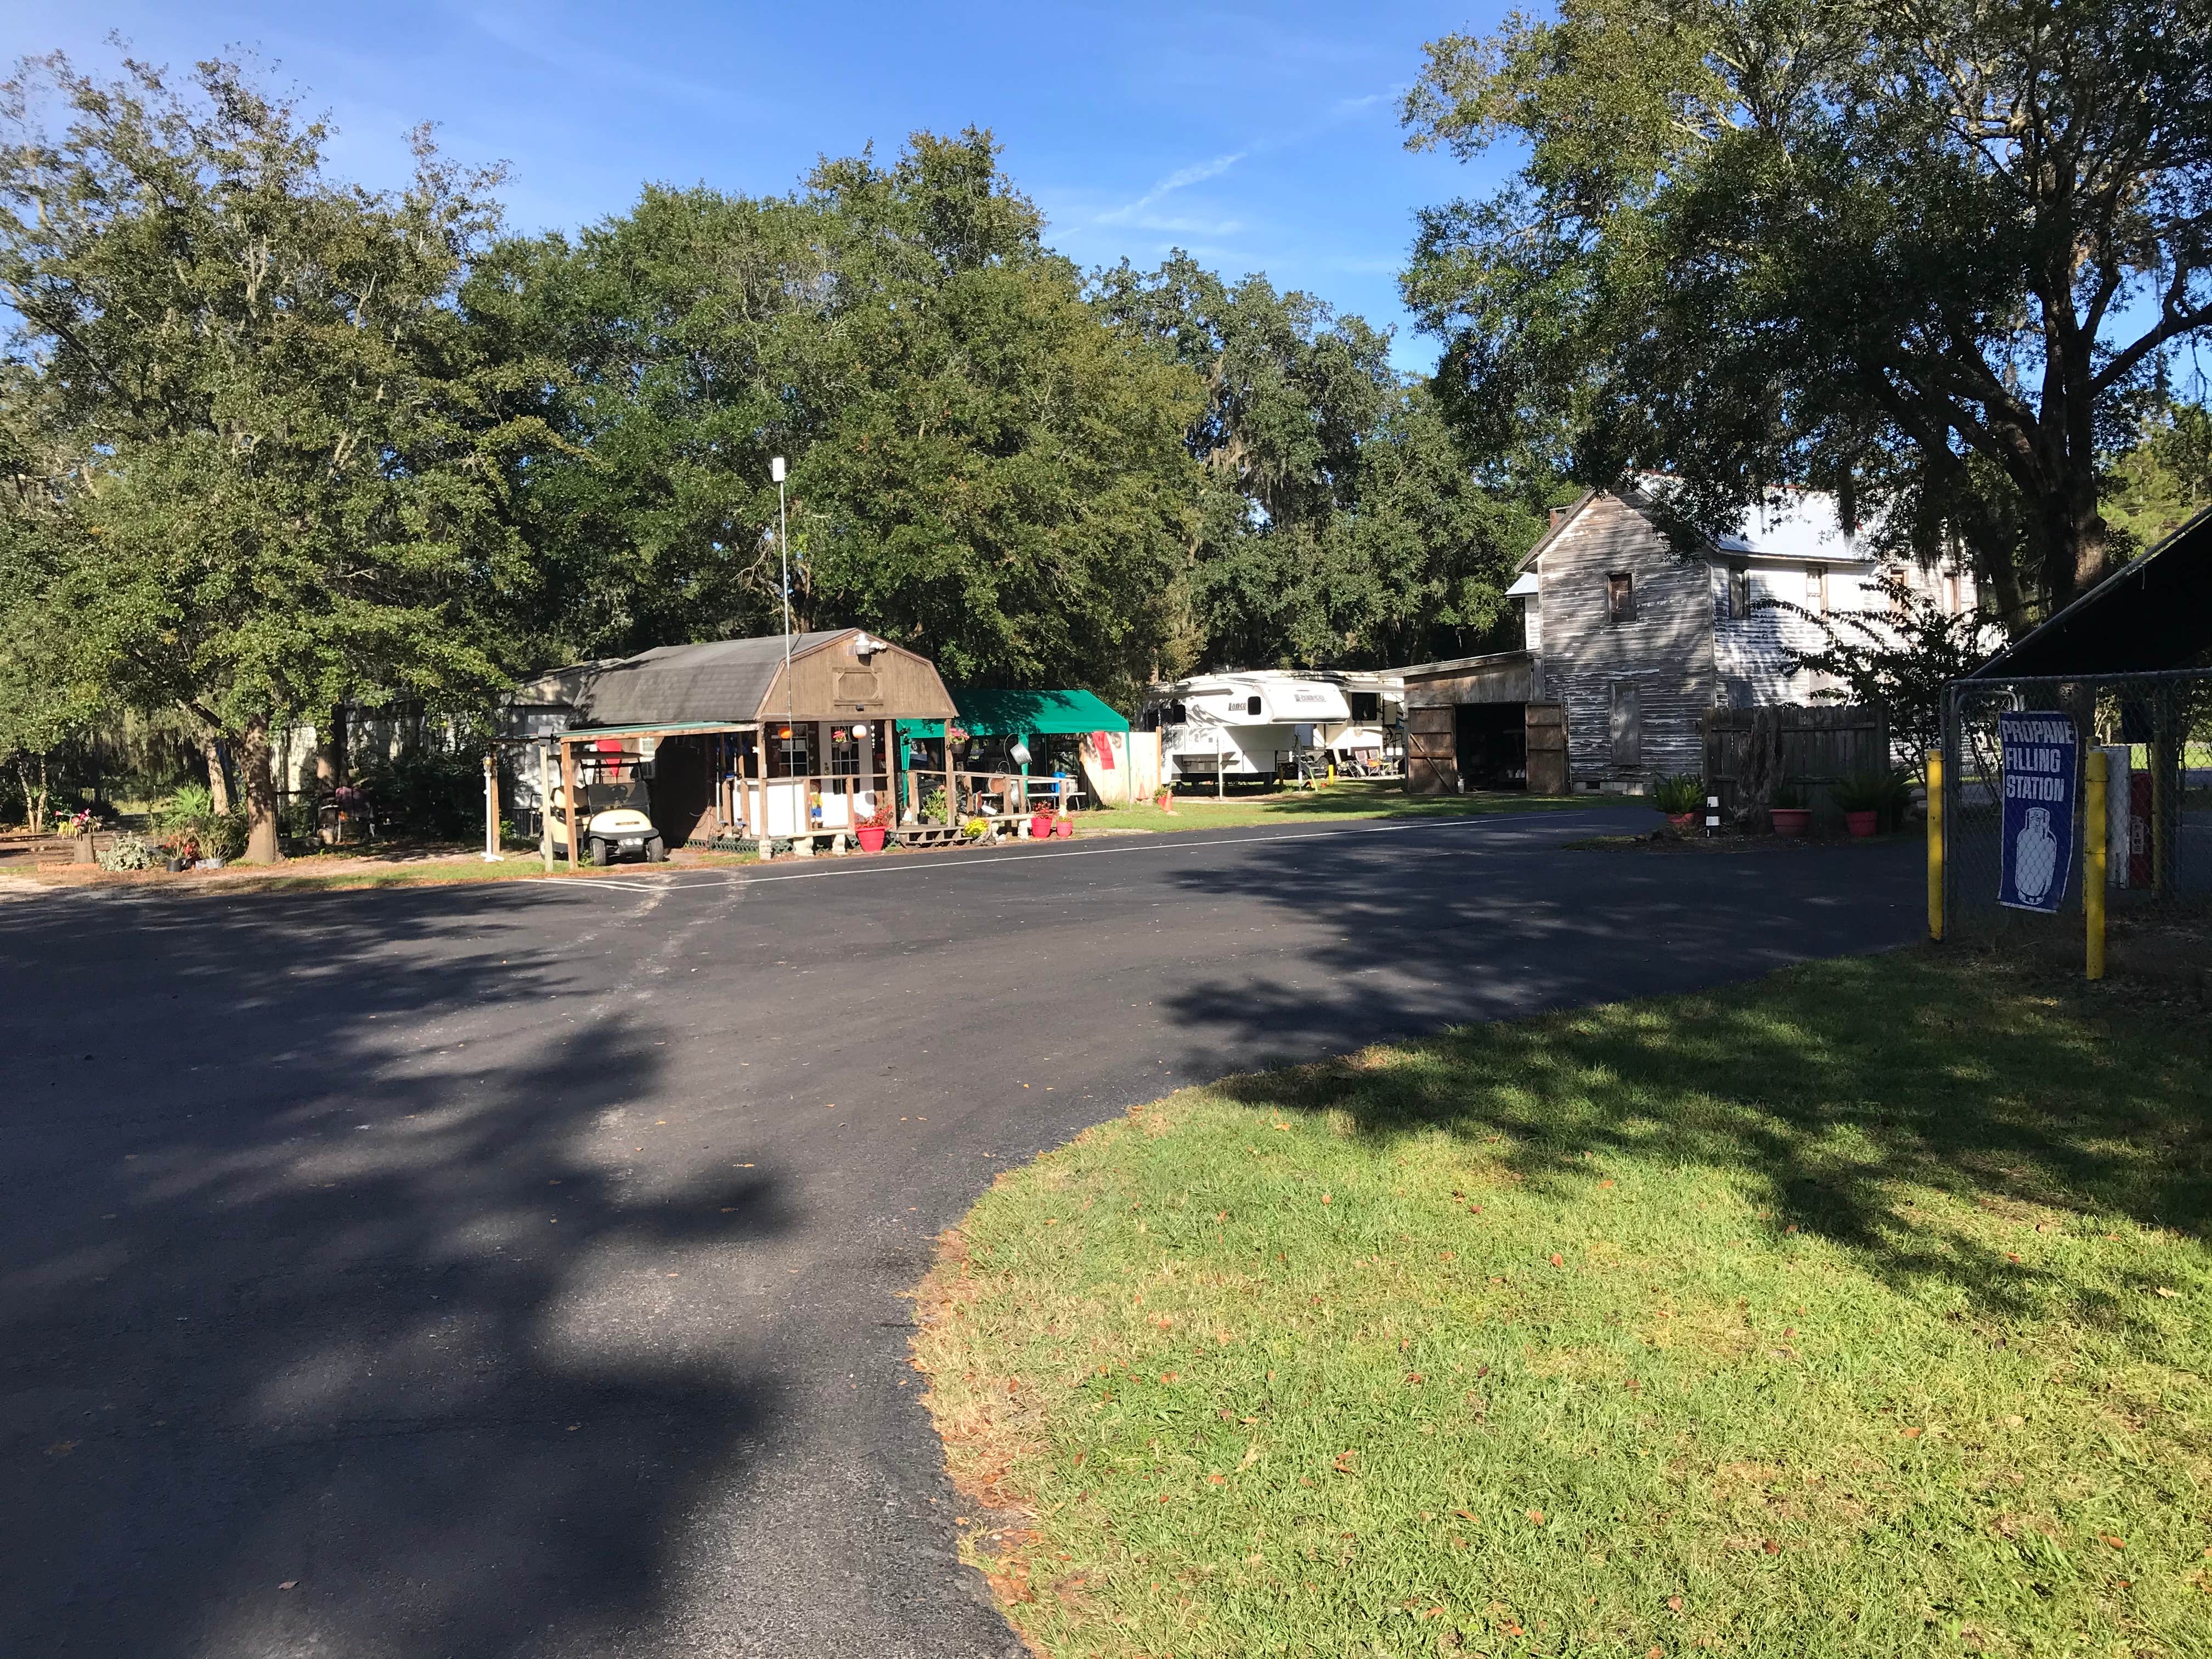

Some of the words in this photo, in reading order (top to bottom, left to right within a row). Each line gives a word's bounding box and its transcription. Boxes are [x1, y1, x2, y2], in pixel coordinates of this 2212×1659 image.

[1228, 702, 1246, 711] Lance
[2001, 720, 2074, 744] PROPANE
[2005, 747, 2061, 772] FILLING
[2006, 775, 2065, 802] STATION
